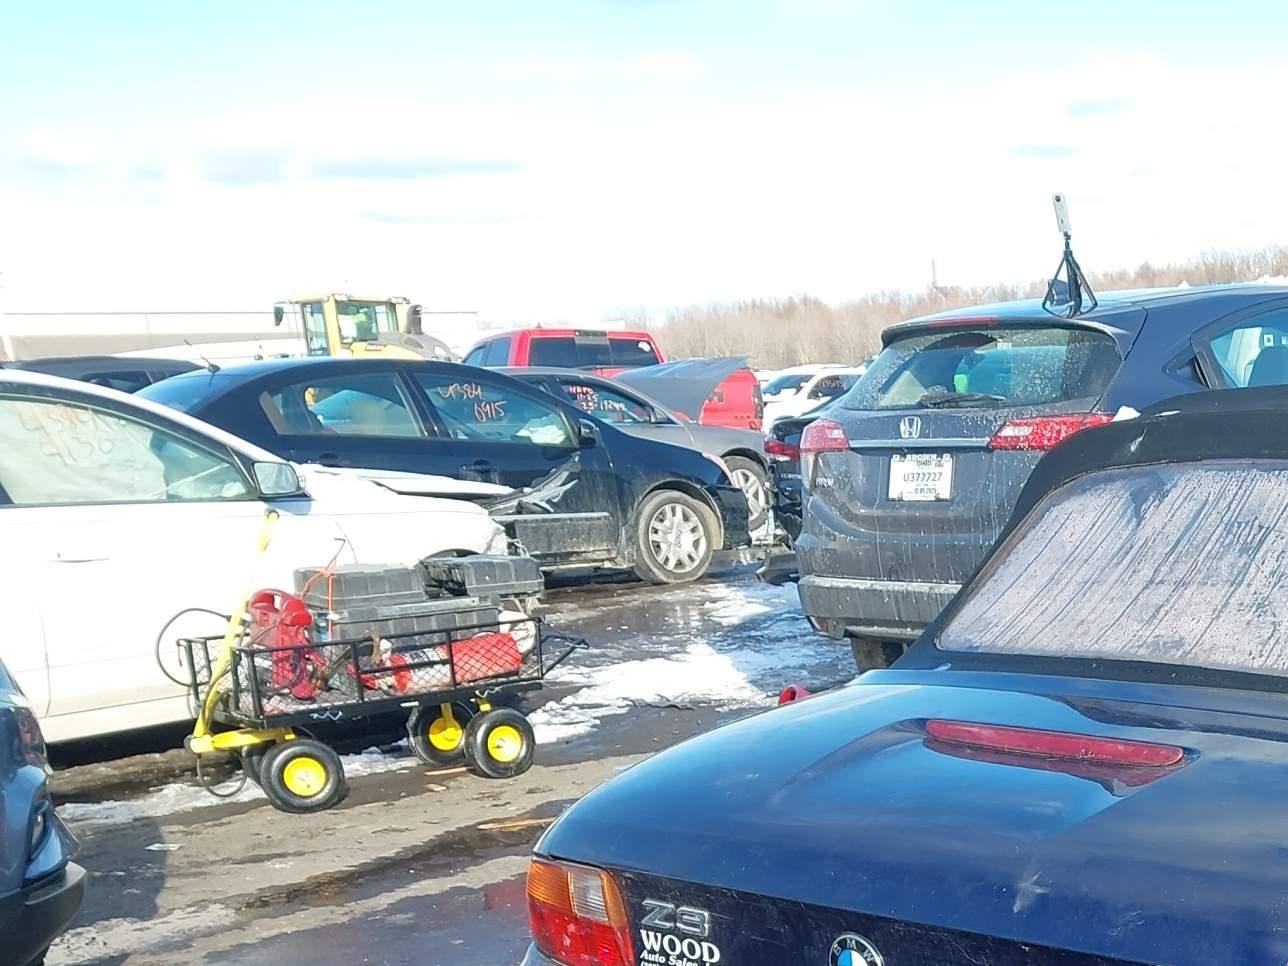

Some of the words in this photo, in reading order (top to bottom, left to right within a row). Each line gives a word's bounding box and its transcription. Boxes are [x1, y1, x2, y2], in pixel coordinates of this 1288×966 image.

[905, 454, 937, 462] BROWN
[903, 472, 943, 482] U377727
[641, 898, 711, 938] Z3
[639, 929, 721, 964] WOOD
[833, 938, 875, 962] BMW
[639, 949, 667, 964] Auto
